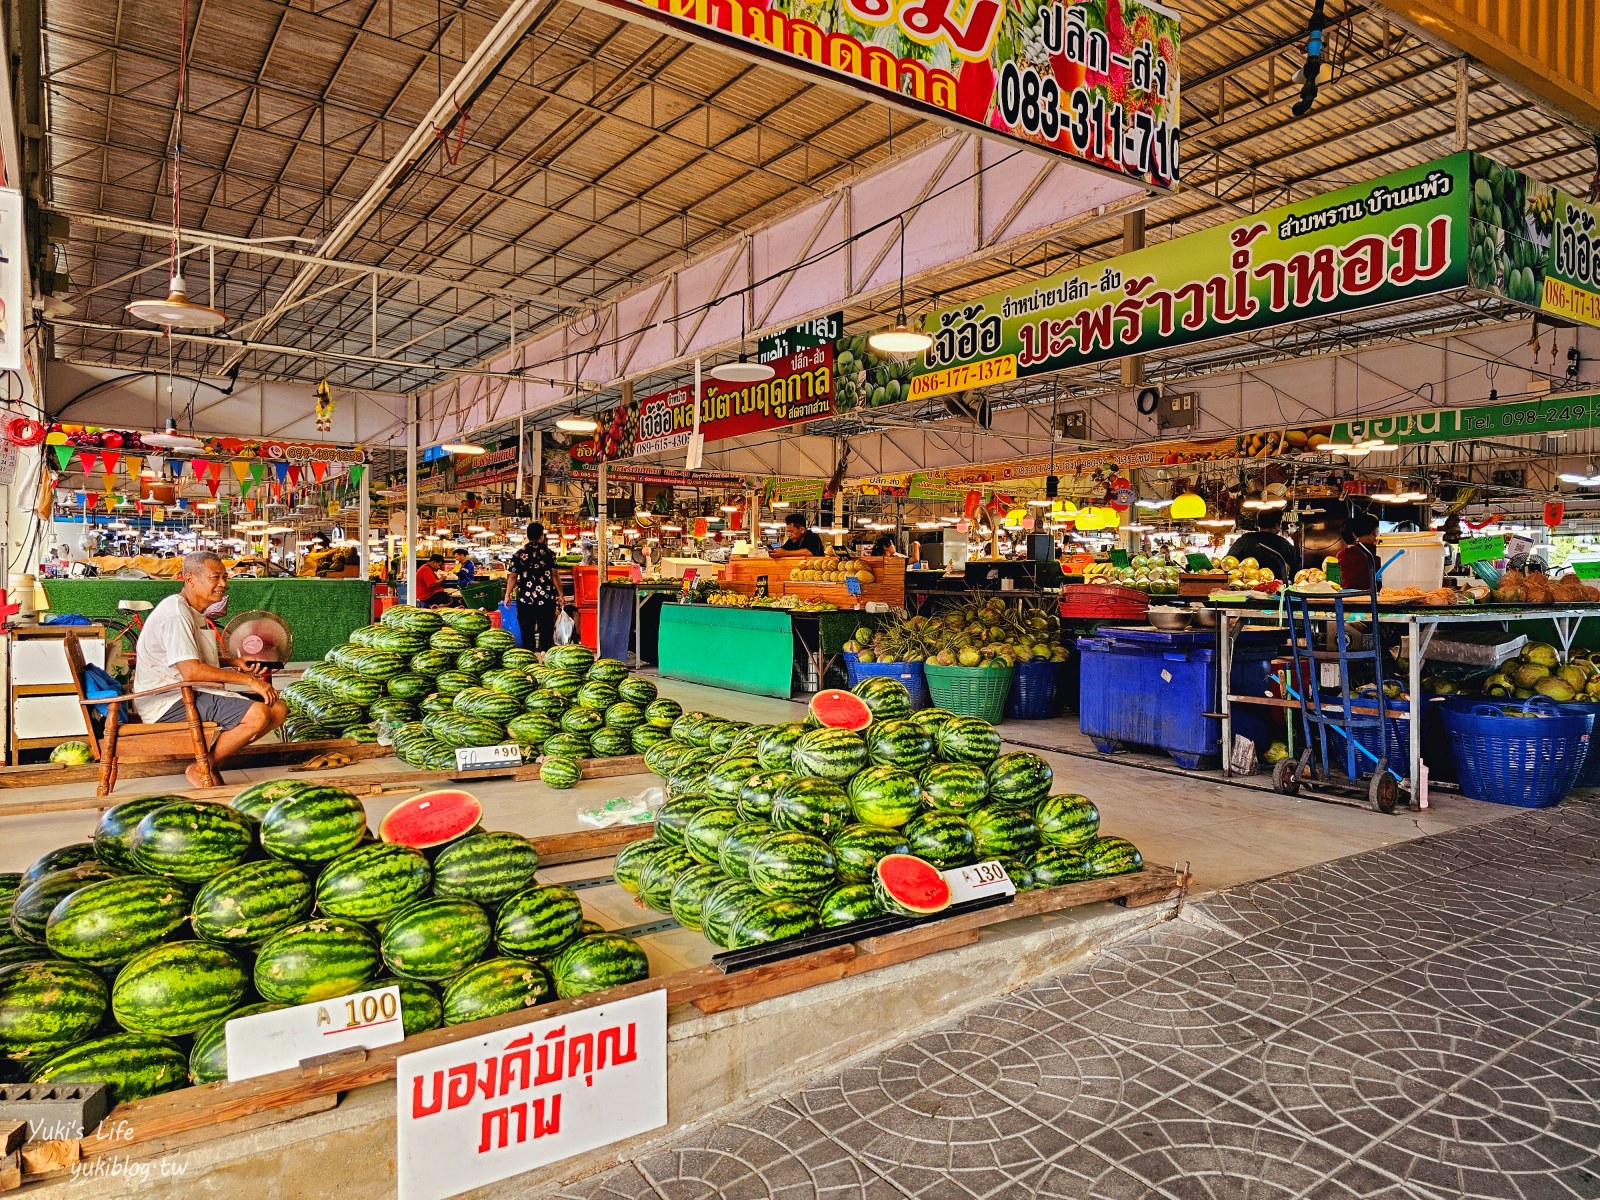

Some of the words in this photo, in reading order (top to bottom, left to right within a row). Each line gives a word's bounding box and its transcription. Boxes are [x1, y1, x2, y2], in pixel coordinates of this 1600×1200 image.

[1280, 201, 1364, 239] สามพราน
[1367, 172, 1451, 214] บ้านแพ้ว
[1018, 217, 1453, 366] มะพร้าวน้ำหอม
[912, 356, 1012, 395] 086-177-1372
[1465, 415, 1495, 430] Tel.
[502, 747, 518, 757] 90
[974, 863, 1004, 883] 130
[316, 1006, 331, 1027] A
[345, 992, 397, 1028] 100
